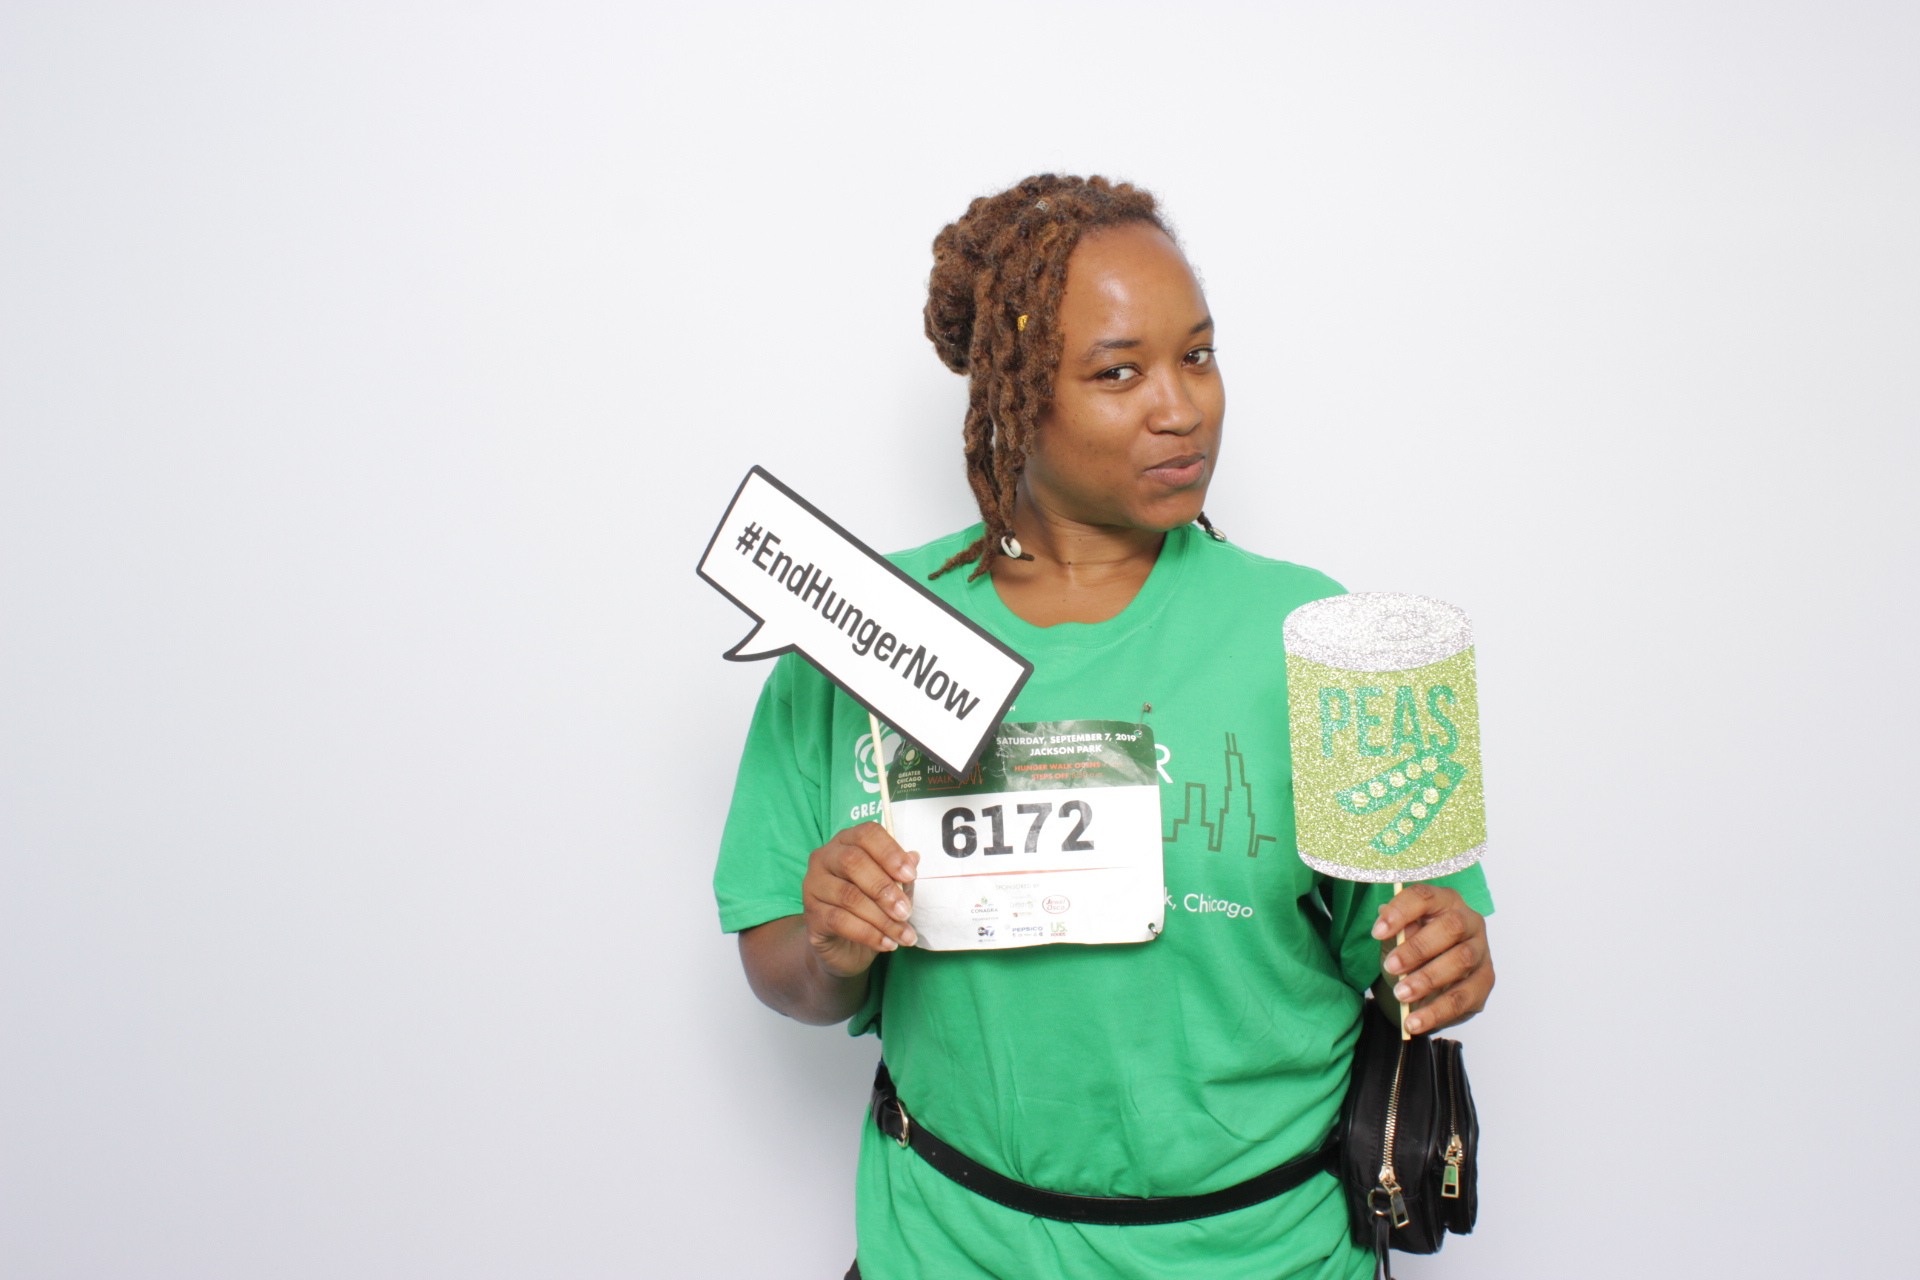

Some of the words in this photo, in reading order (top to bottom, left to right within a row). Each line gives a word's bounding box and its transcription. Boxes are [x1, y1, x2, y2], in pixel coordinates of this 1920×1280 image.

[735, 521, 981, 721] #EndHungerNow
[1319, 685, 1458, 758] PEAS
[996, 737, 1047, 746] SATURDAY,
[1050, 734, 1102, 744] SEPTEMBER
[1104, 733, 1112, 742] 7,
[1115, 733, 1137, 742] 2019
[1029, 747, 1074, 757] JACKSON
[1077, 744, 1102, 754] PARK
[898, 770, 920, 778] GREATER
[1014, 764, 1048, 772] HUNGER
[928, 776, 953, 784] WALK
[1031, 773, 1054, 781] STEPS
[941, 800, 1094, 858] 6172
[1046, 898, 1066, 906] Jewel
[1183, 893, 1254, 918] Chicago
